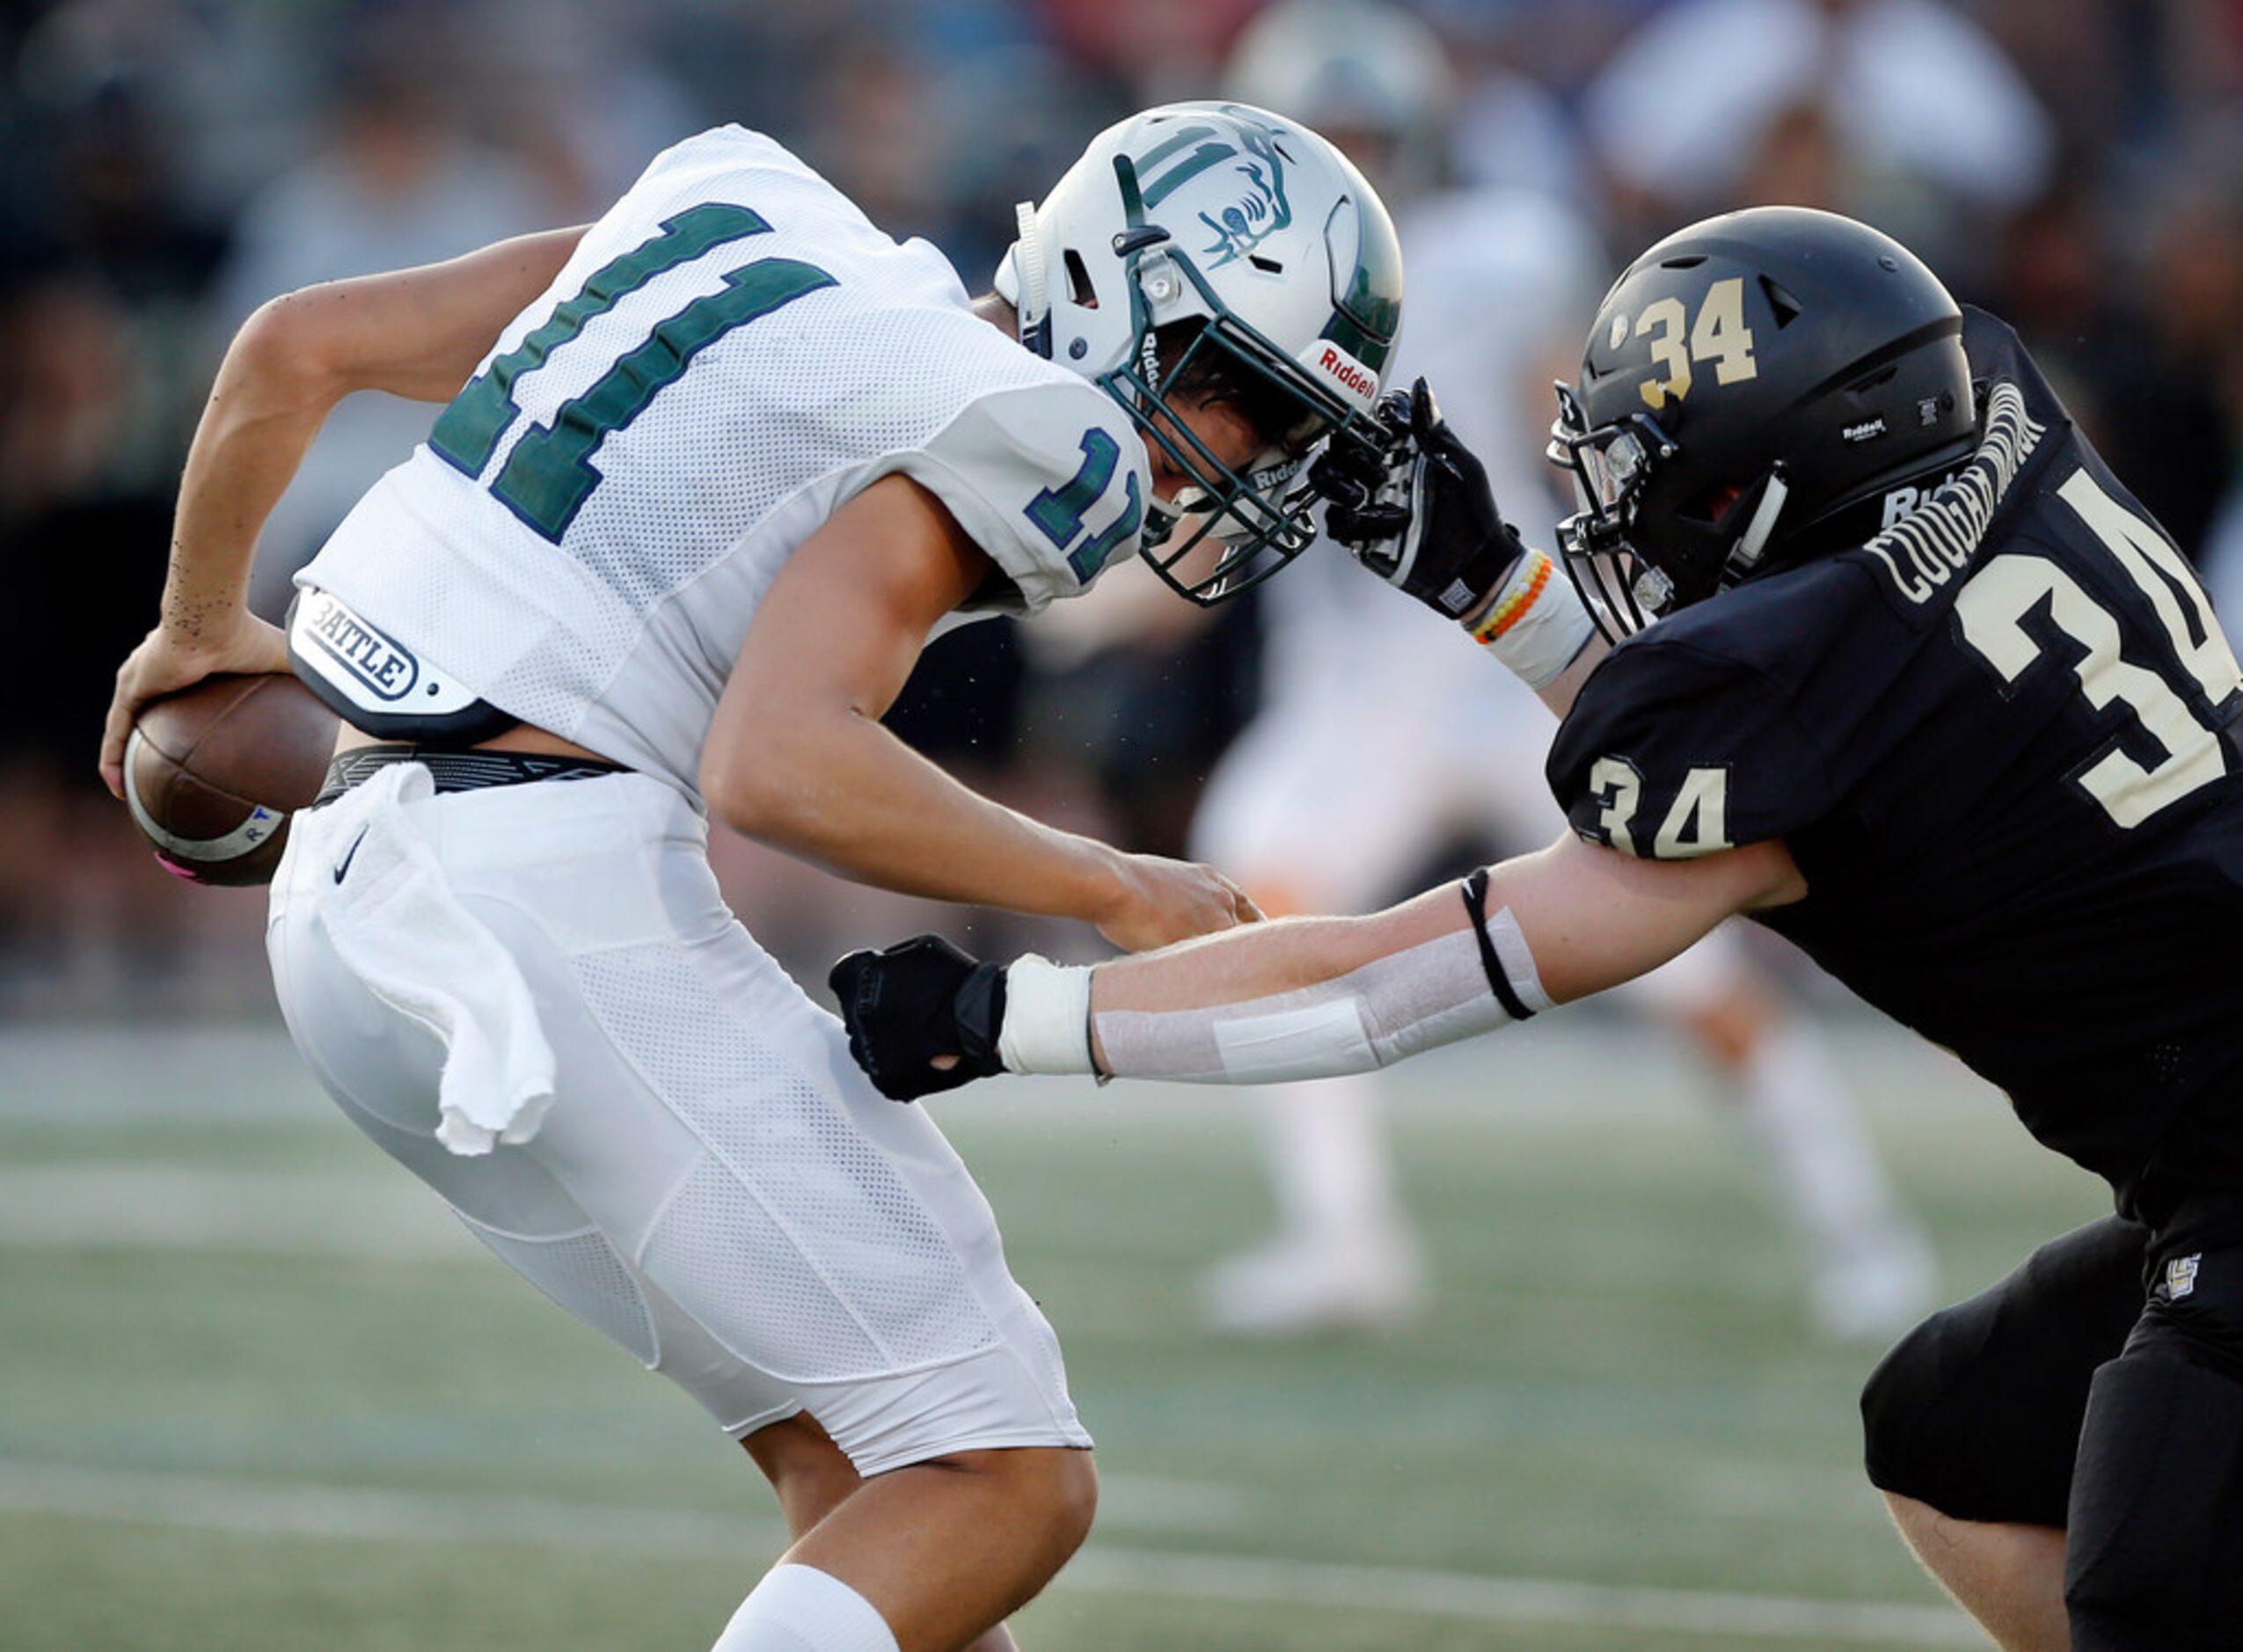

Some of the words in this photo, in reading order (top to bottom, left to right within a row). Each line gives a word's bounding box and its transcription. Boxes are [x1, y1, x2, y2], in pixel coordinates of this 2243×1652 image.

[427, 201, 842, 546] 11
[1635, 277, 1757, 410] 34
[1022, 426, 1143, 587] 11
[1954, 467, 2243, 830] 34
[1583, 755, 1735, 859] 34
